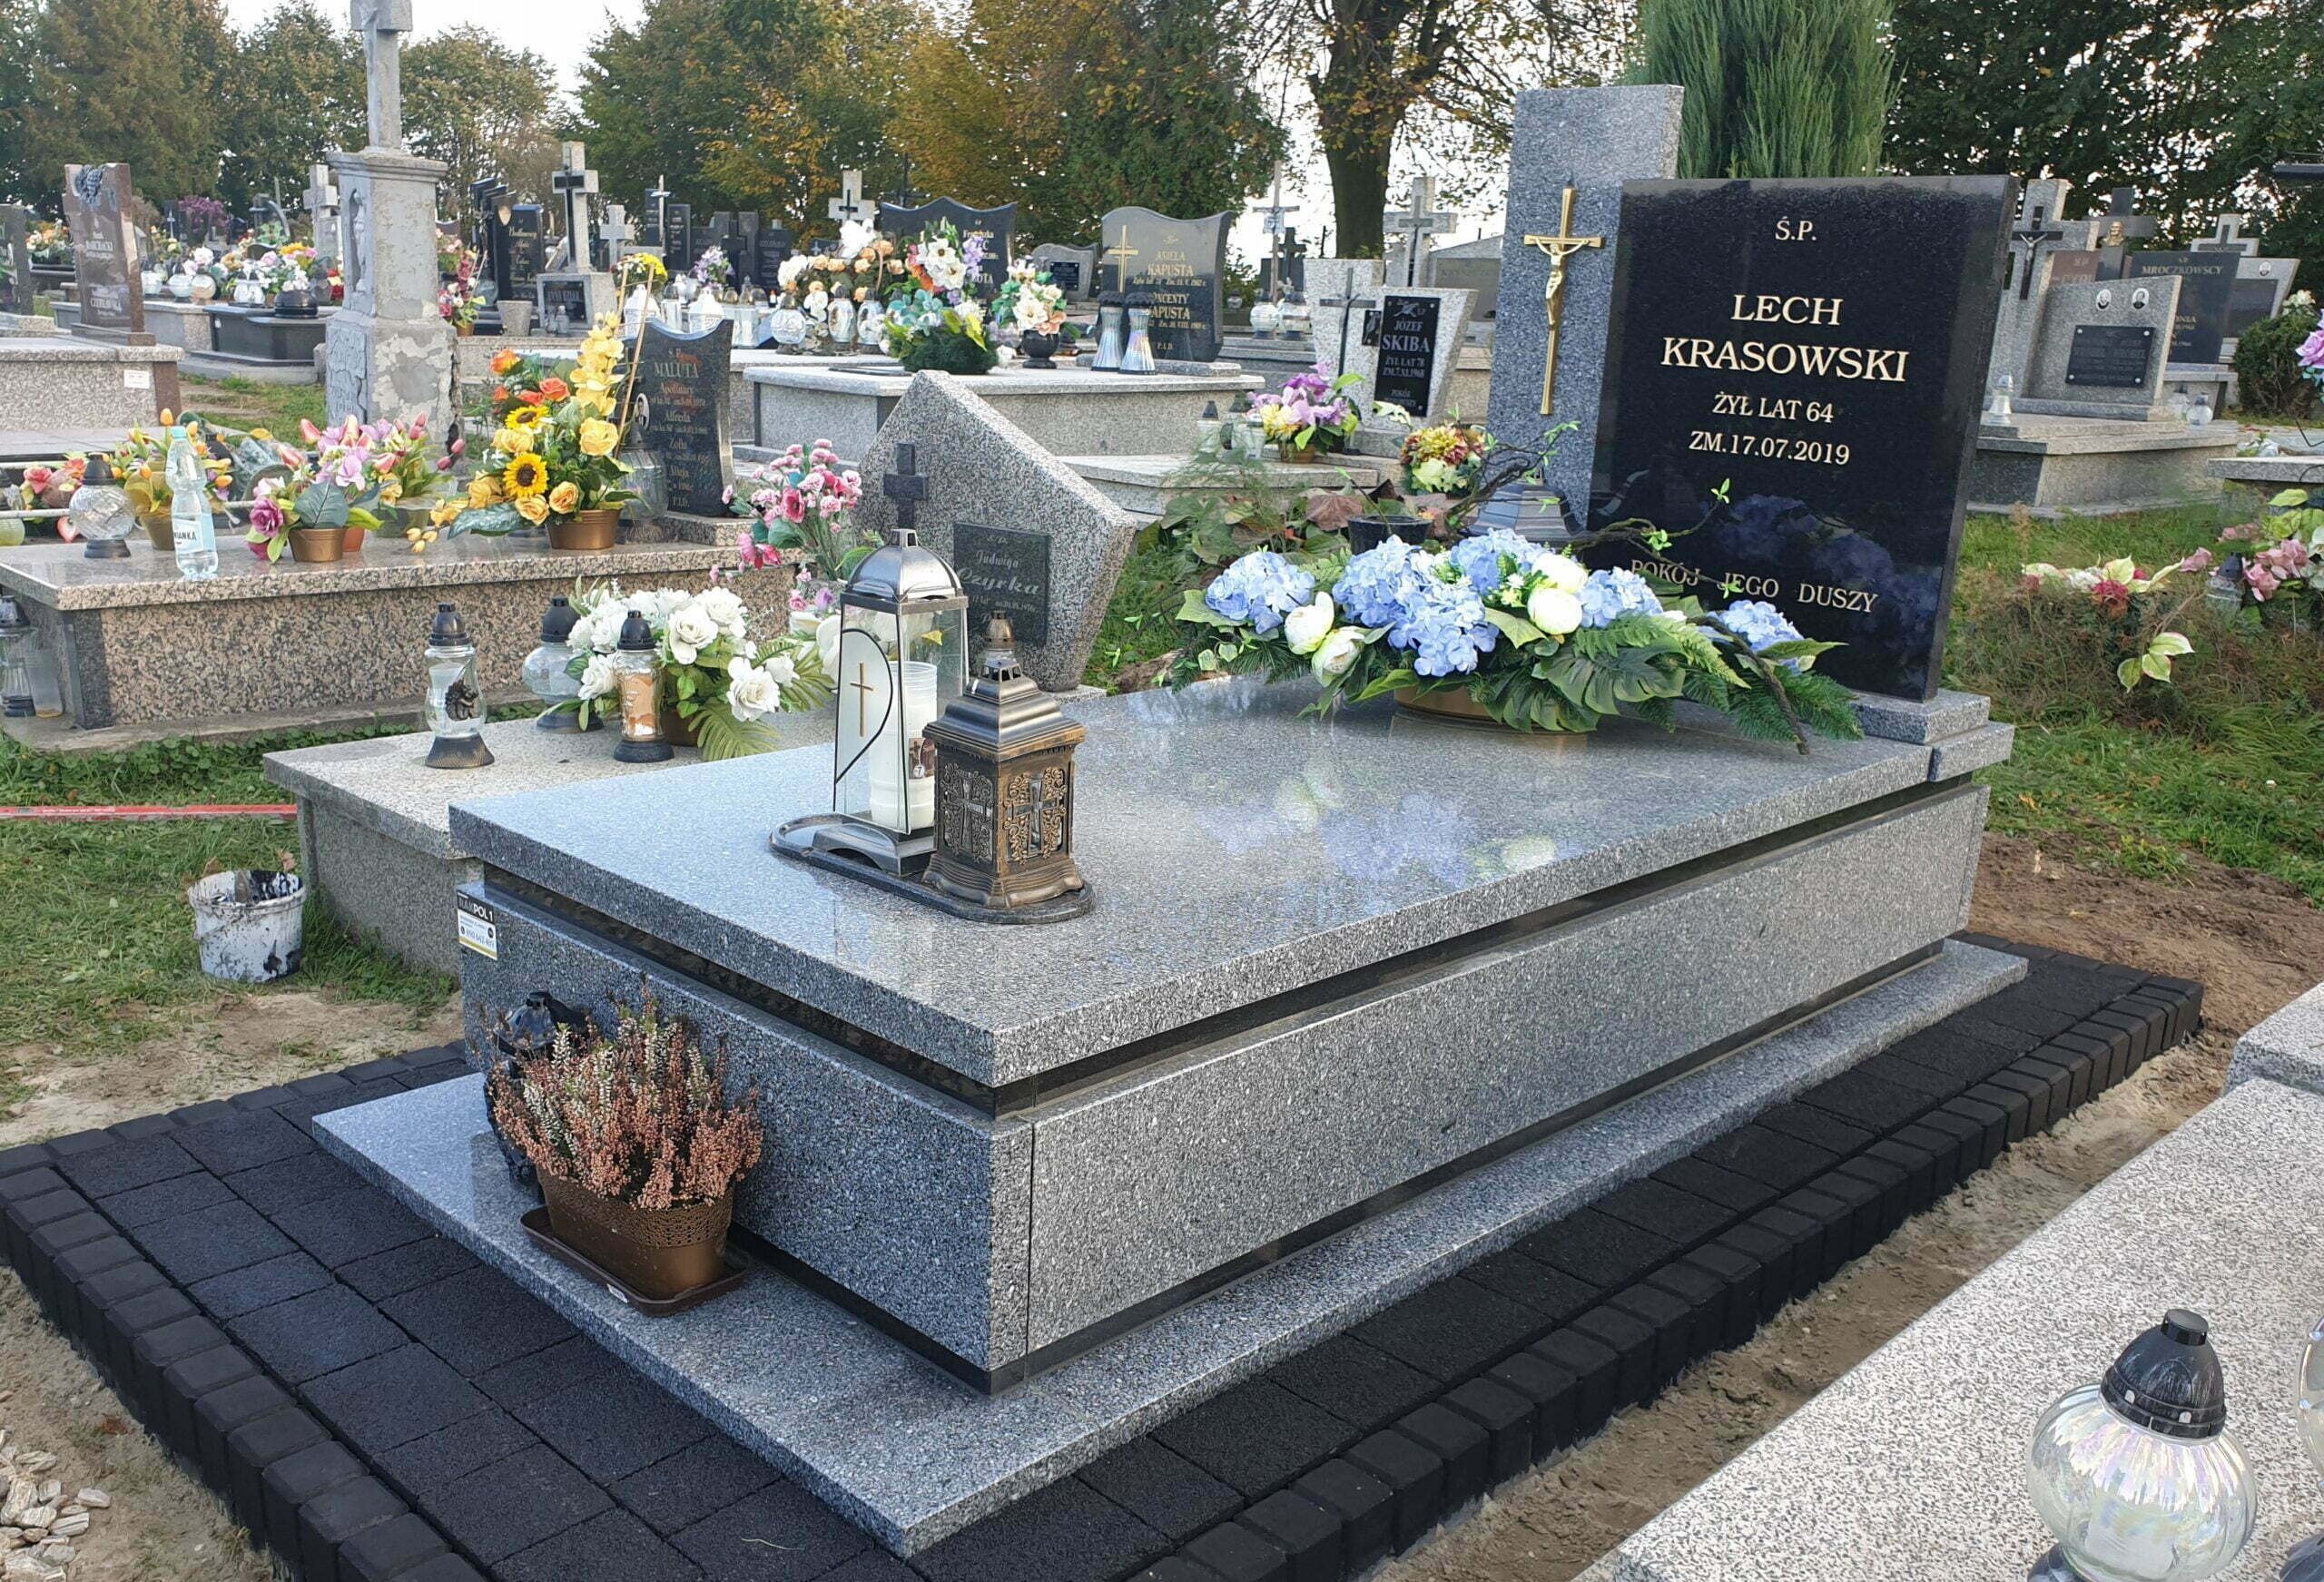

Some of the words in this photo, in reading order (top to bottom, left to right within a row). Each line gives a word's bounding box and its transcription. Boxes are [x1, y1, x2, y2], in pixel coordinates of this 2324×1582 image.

[1775, 215, 1817, 241] Ś.P.
[1147, 262, 1195, 277] KAPUSTA
[2142, 265, 2223, 276] MROCZKOWSCY
[1730, 293, 1844, 326] LECH
[1393, 318, 1423, 332] JÓZEF
[1382, 333, 1431, 353] SKIBA
[1660, 336, 1910, 382] KRASOWSKI
[1712, 390, 1754, 417] ŻYŁ
[1758, 397, 1802, 421] LAT
[1806, 401, 1835, 424] 64
[974, 548, 1019, 571] Jadwiga
[956, 566, 1039, 595] Czyrka
[1716, 572, 1780, 598] JEGO
[1797, 582, 1879, 614] DUSZY
